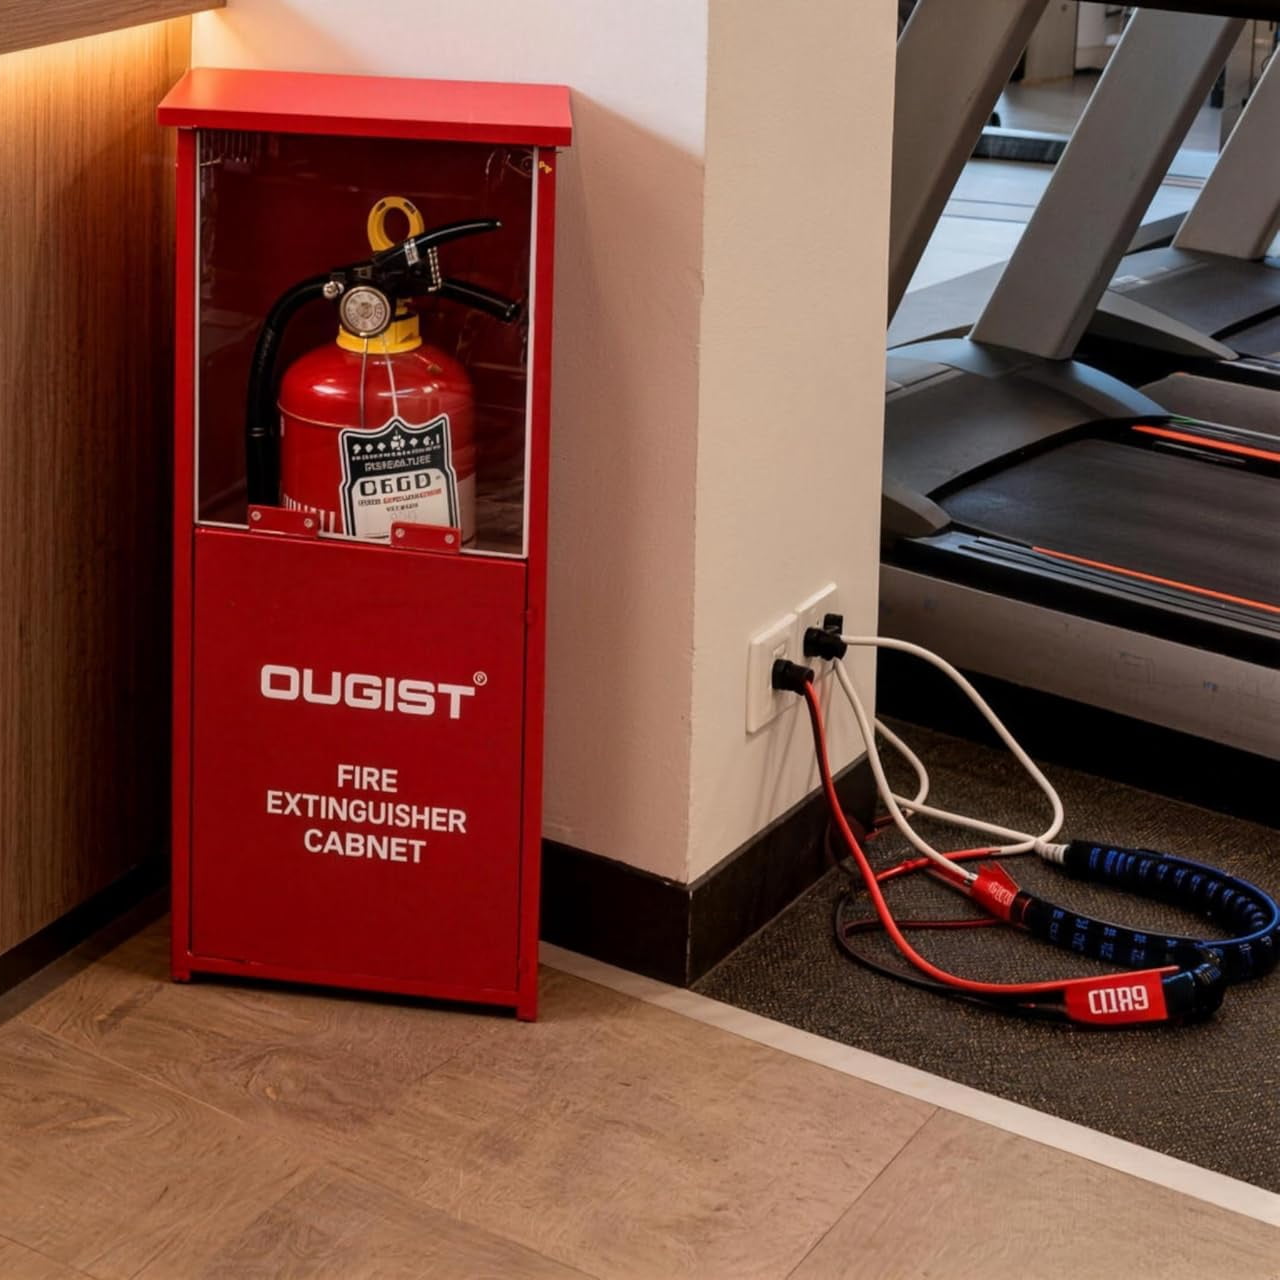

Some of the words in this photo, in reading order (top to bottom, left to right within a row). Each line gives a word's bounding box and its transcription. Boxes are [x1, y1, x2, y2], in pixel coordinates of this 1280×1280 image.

[261, 664, 476, 719] OUGIST
[337, 764, 398, 793] FIRE
[266, 790, 467, 833] EXTINGUISHER
[304, 829, 427, 864] CABNET
